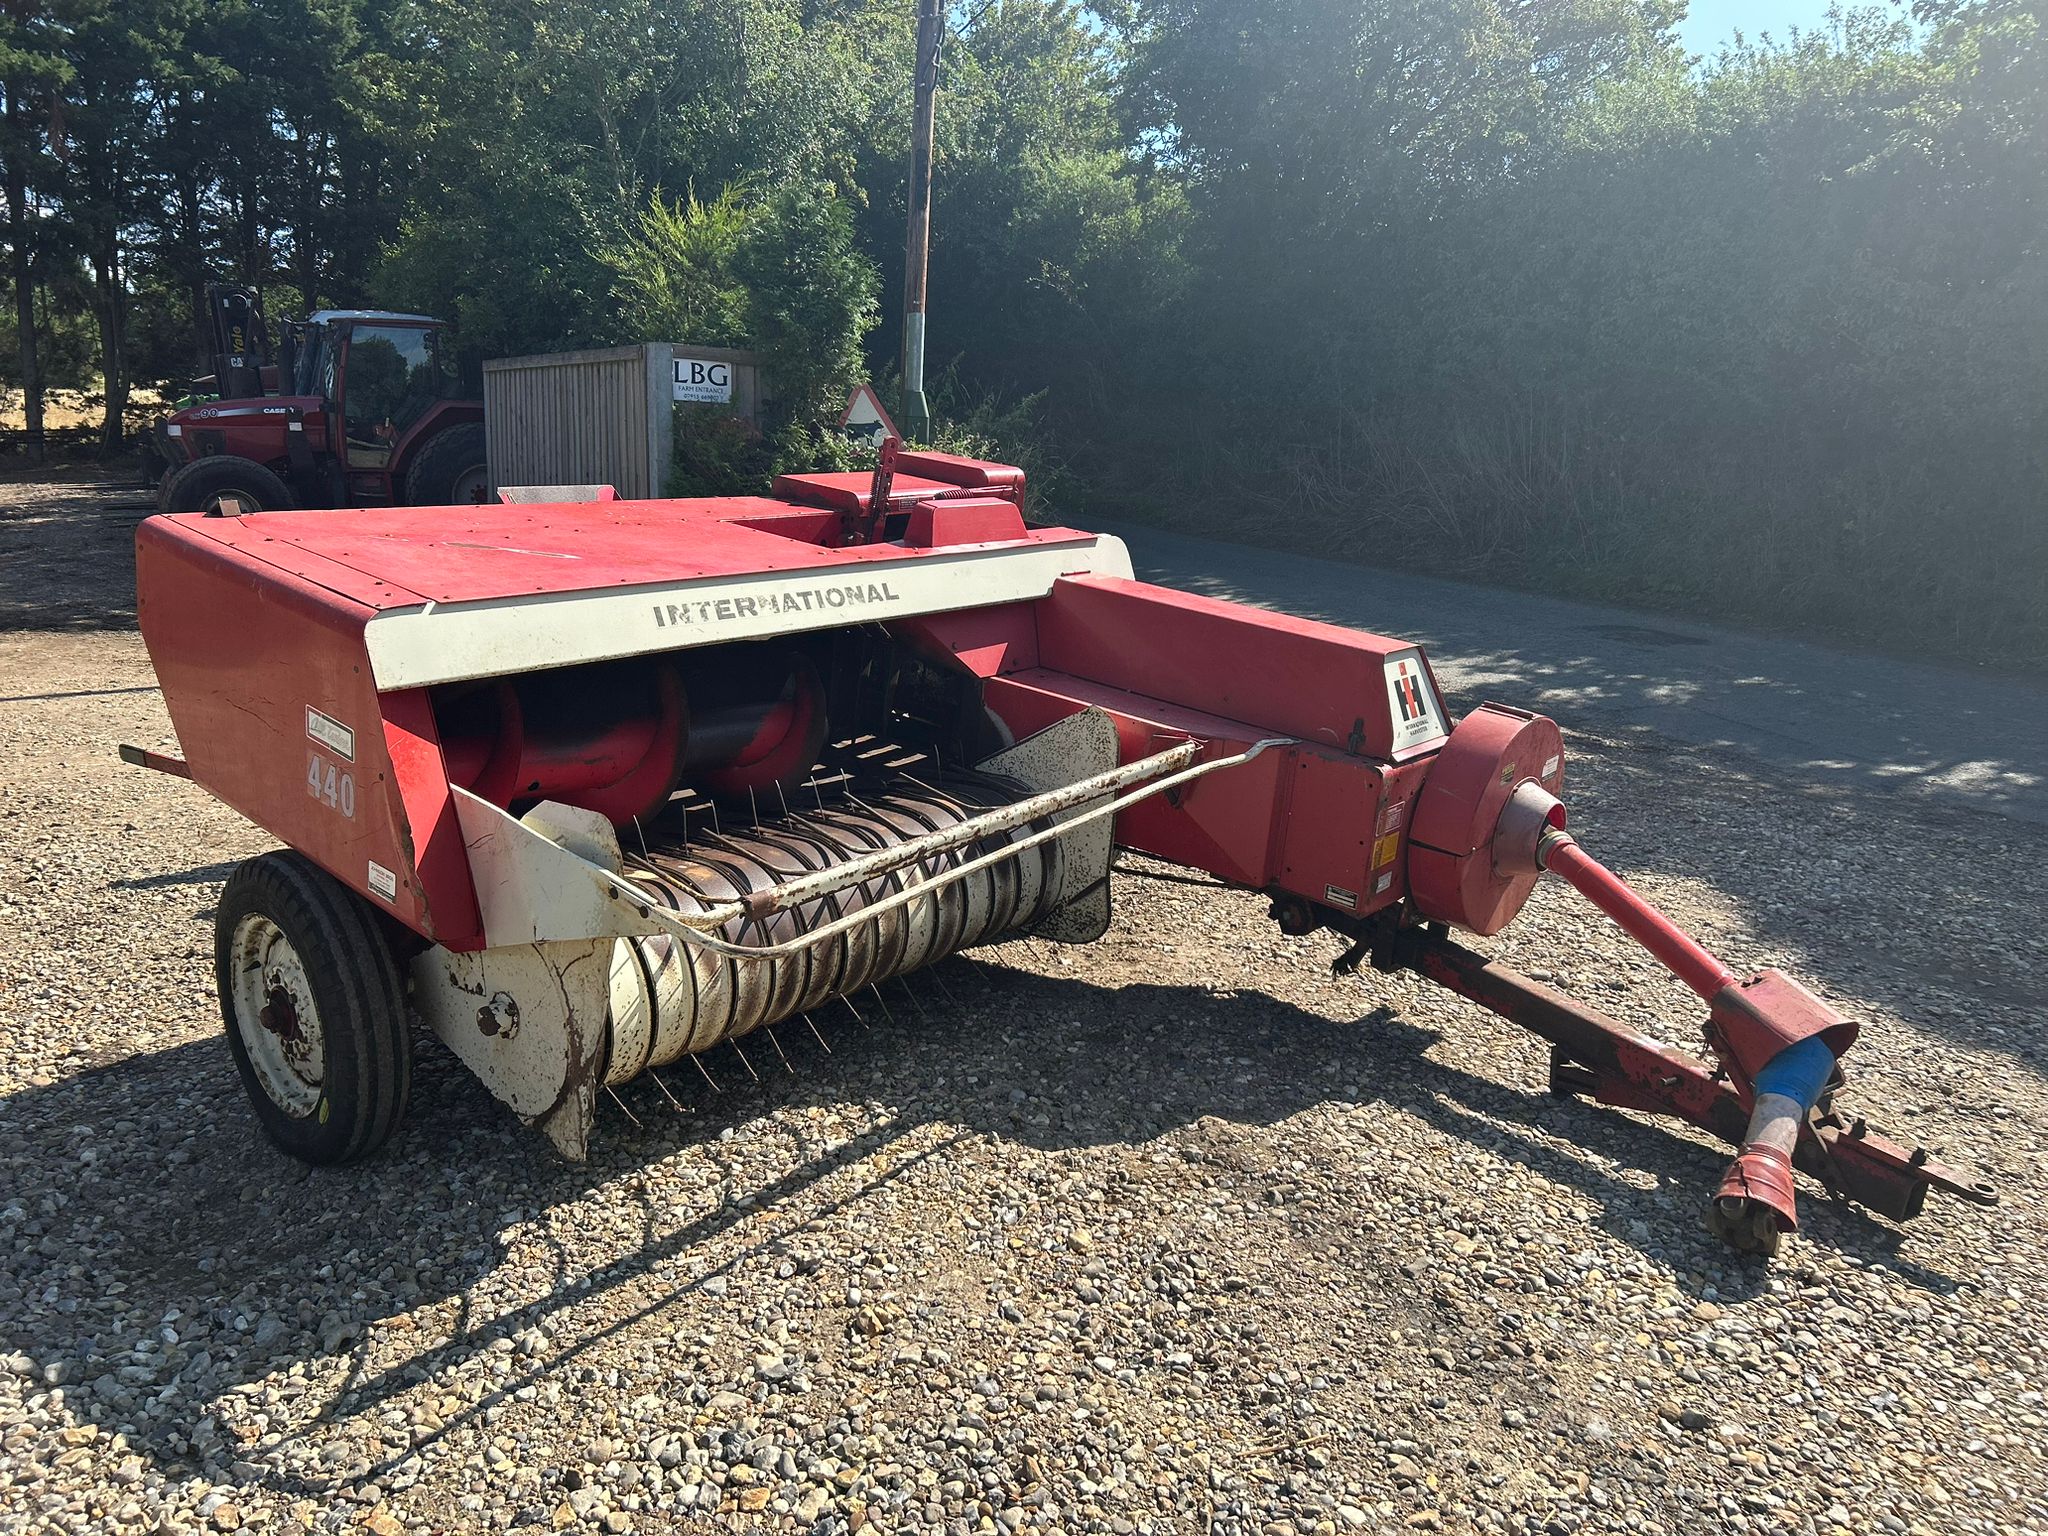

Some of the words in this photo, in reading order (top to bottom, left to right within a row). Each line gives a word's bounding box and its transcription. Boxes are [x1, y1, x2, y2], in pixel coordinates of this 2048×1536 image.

[232, 326, 245, 353] Yale
[230, 357, 243, 367] CA
[674, 361, 728, 386] LBG
[653, 583, 901, 628] INTERNATIONAL
[308, 755, 355, 819] 440
